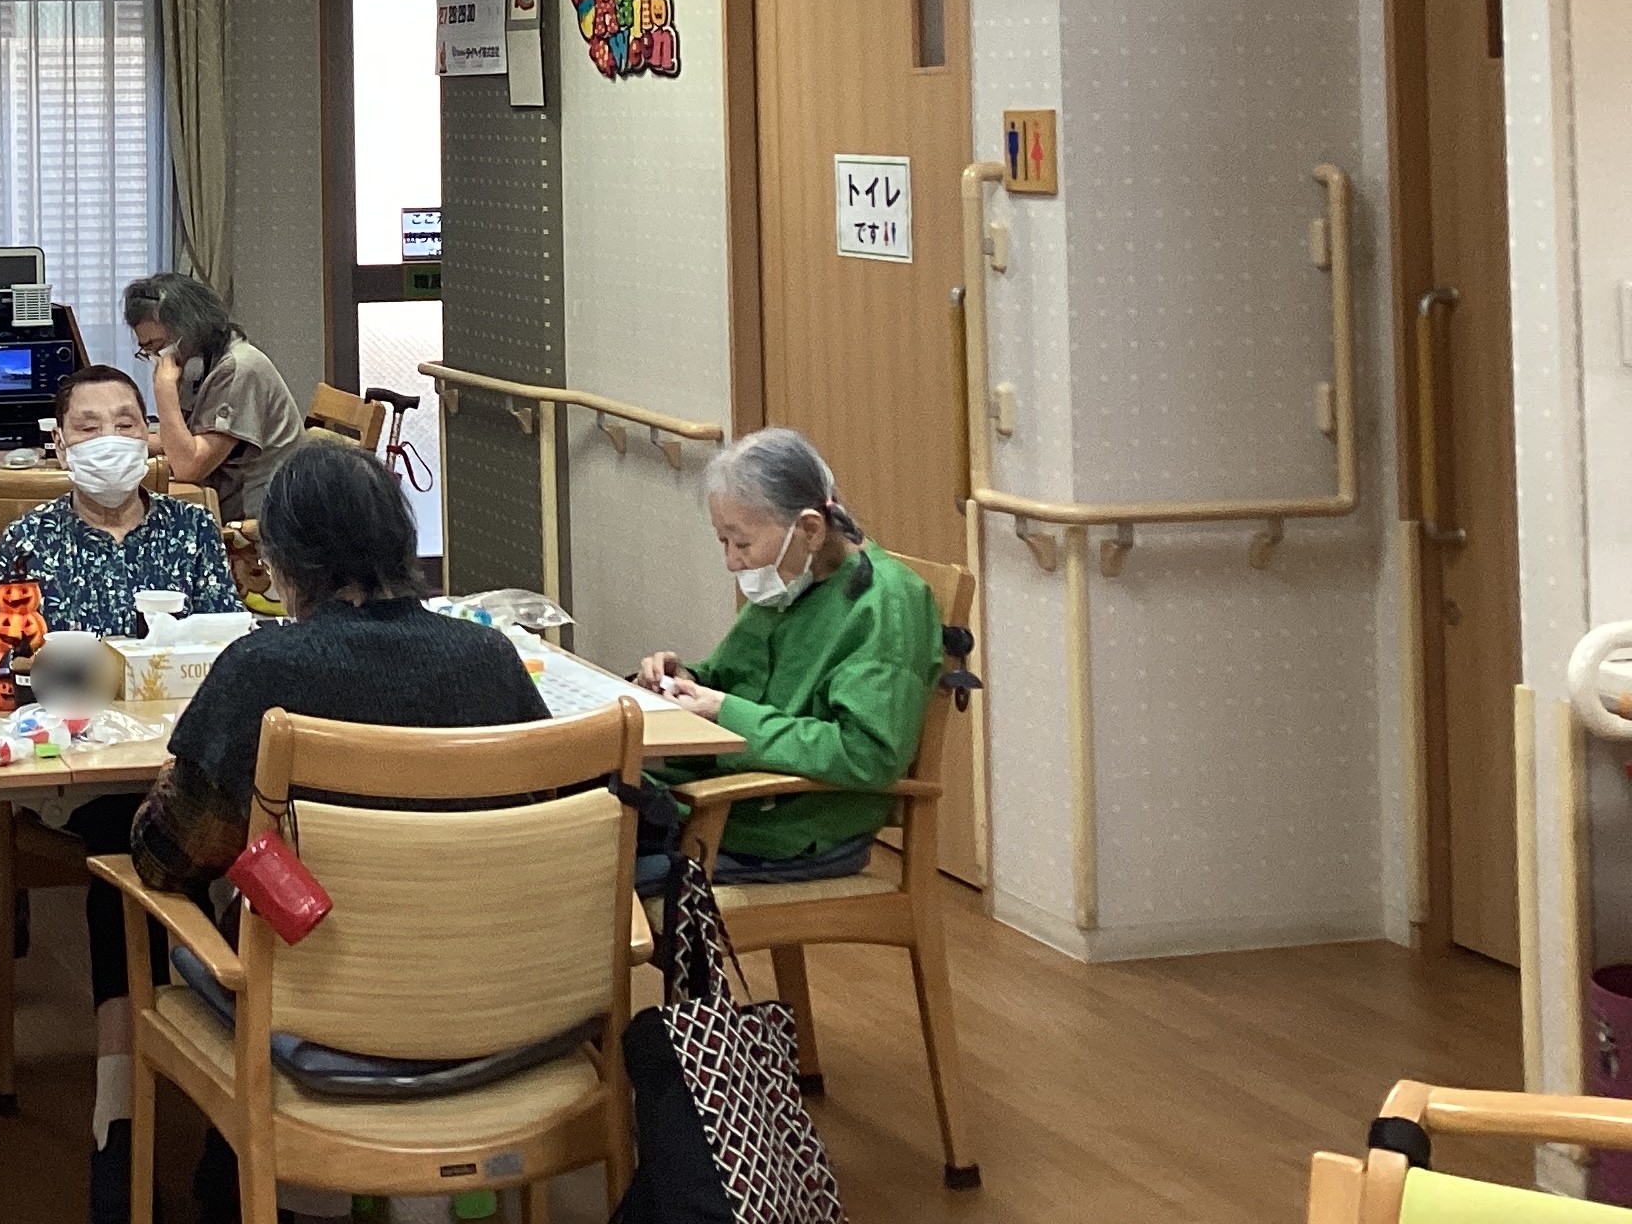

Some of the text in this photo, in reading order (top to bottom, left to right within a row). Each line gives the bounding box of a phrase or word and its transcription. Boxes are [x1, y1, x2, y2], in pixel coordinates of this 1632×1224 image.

[848, 174, 901, 208] トイレ
[854, 222, 880, 245] です
